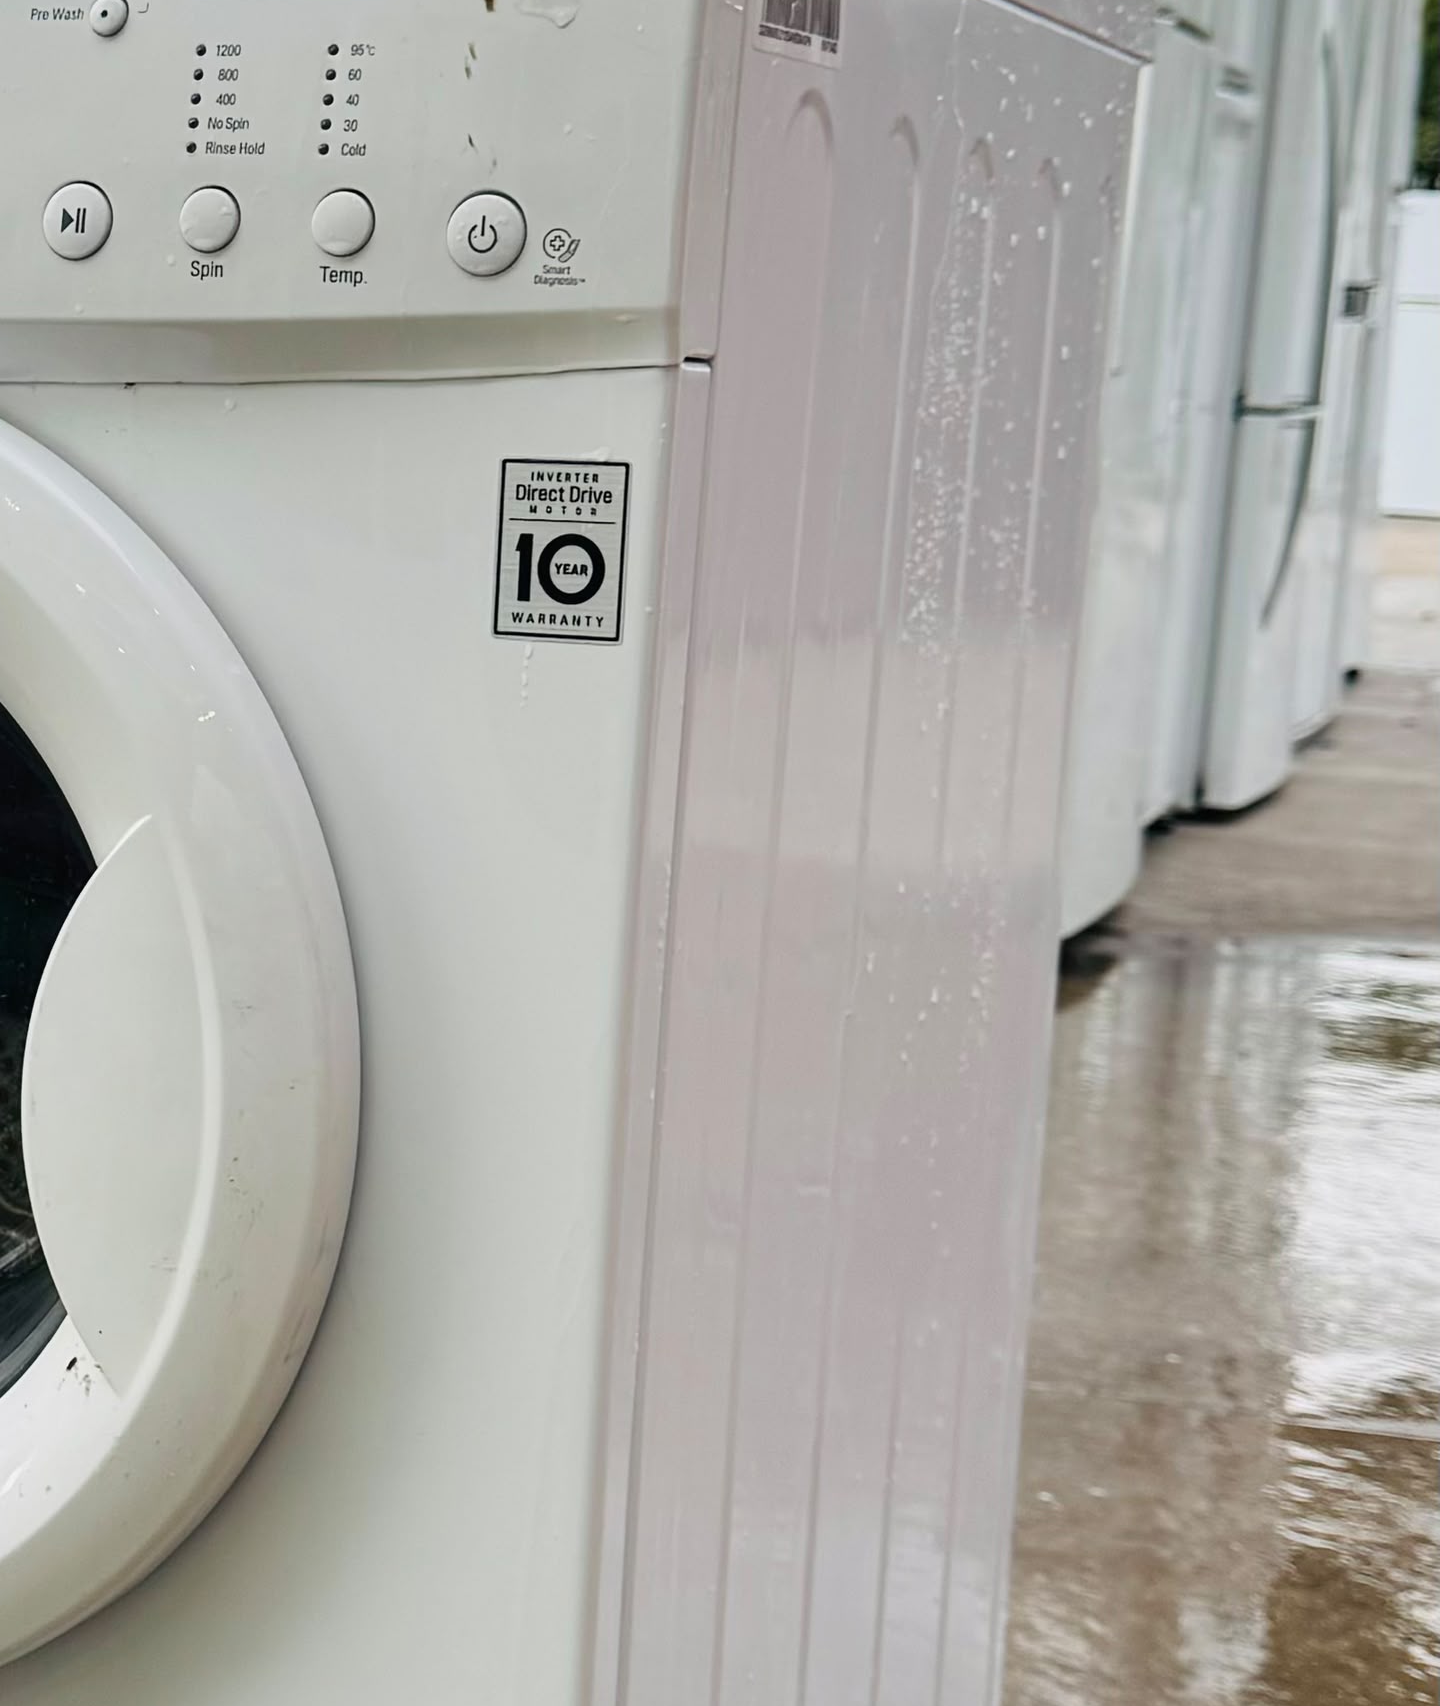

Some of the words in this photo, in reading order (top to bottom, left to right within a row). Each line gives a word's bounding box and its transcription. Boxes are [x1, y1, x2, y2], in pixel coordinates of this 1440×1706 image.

[30, 8, 49, 21] Pre
[52, 8, 84, 21] Wash
[216, 44, 241, 57] 1200
[217, 68, 239, 82] 800
[348, 68, 362, 81] 60
[216, 93, 236, 106] 400
[346, 94, 360, 107] 40
[207, 118, 223, 130] No
[225, 118, 250, 132] Spin
[343, 119, 358, 132] 30
[205, 143, 236, 155] Rinse
[239, 142, 265, 155] Hold
[341, 143, 366, 156] Cold
[190, 260, 224, 281] Spin
[319, 265, 368, 287] Temp.
[542, 264, 571, 275] Smart
[531, 471, 600, 484] INVERTER
[516, 484, 565, 502] Direct
[569, 486, 613, 504] Drive
[529, 505, 597, 516] MOTOR
[515, 532, 606, 605] 10
[554, 563, 589, 576] YEAR
[511, 611, 604, 628] WARRANTY
